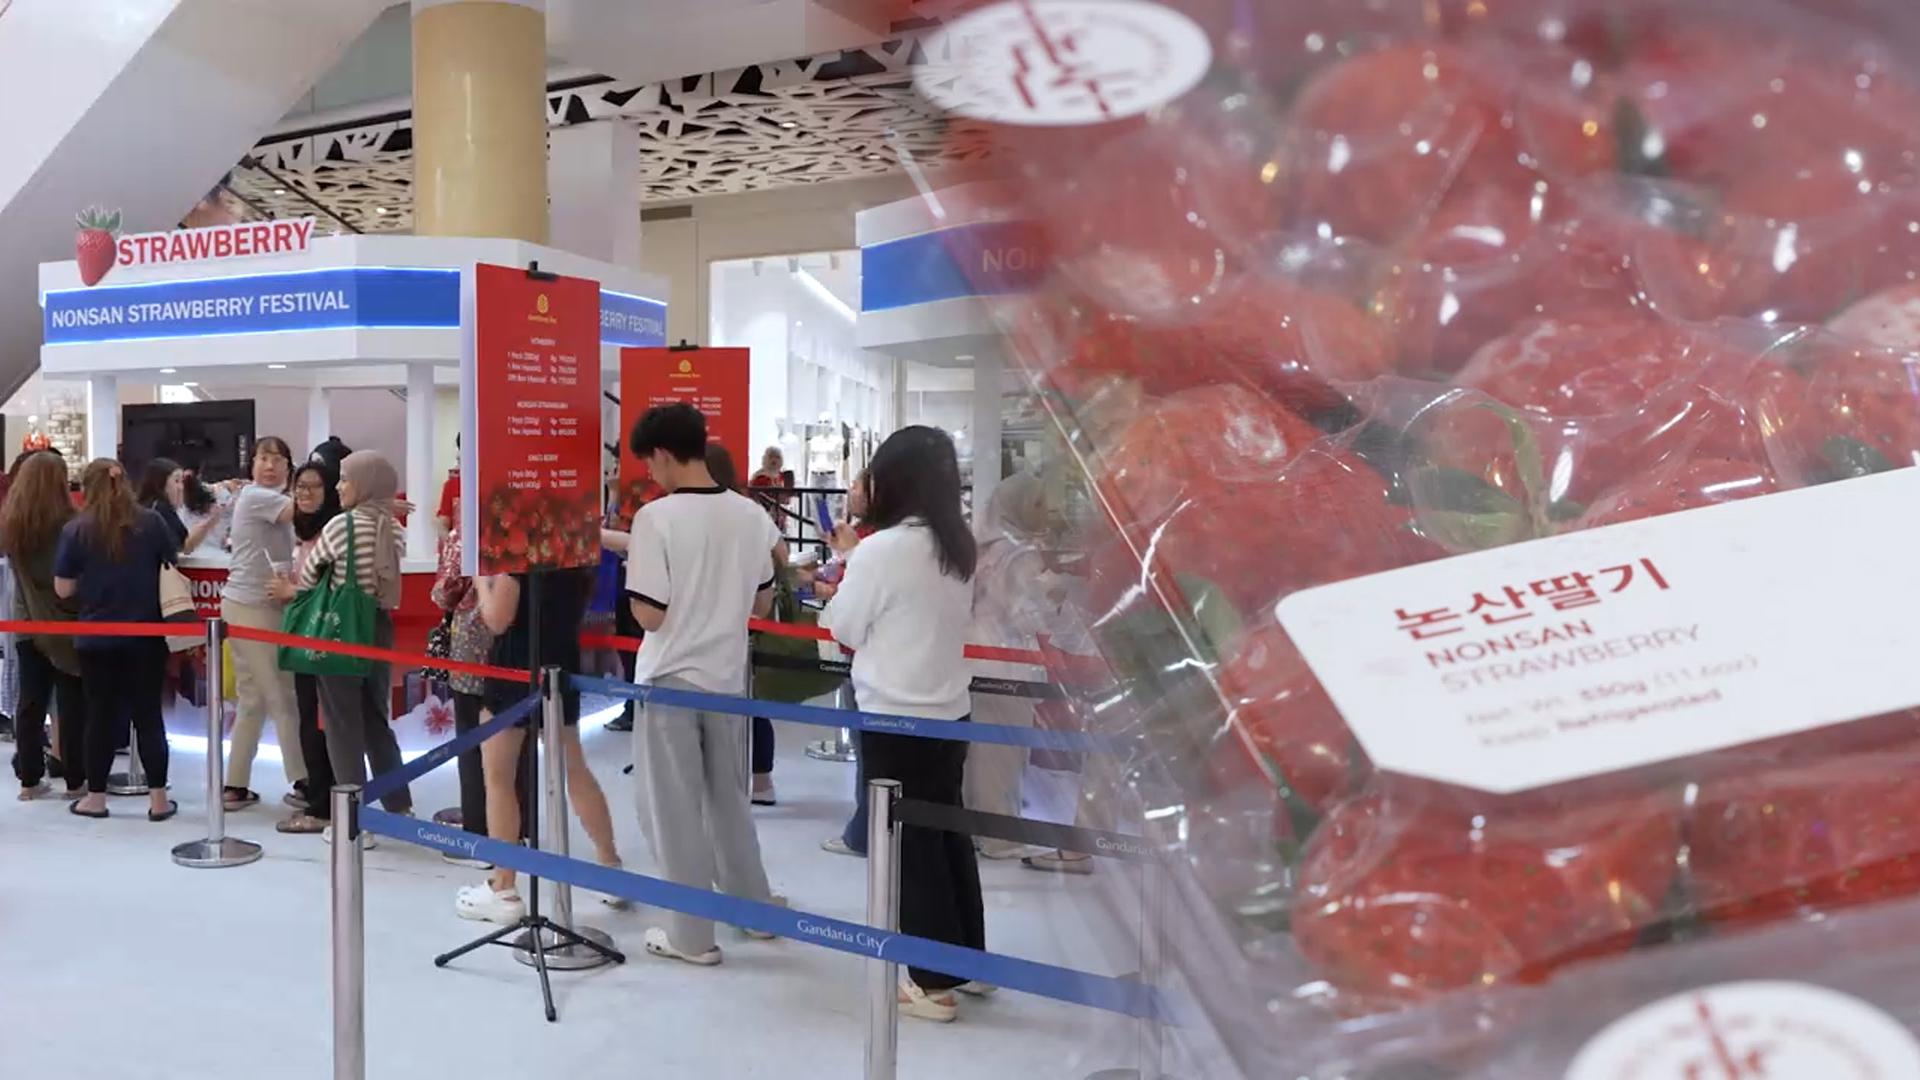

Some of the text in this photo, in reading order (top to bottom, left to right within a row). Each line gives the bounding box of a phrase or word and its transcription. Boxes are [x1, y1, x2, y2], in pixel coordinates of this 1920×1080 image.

[118, 221, 312, 266] STRAWBERRY
[52, 290, 350, 328] NONSAN STRAWBERRY FESTIVAL
[1394, 557, 1671, 641] 논산딸기
[1426, 618, 1594, 668] NONSAN
[1441, 624, 1700, 693] STRAWBERRY
[796, 919, 892, 957] Gandaria City
